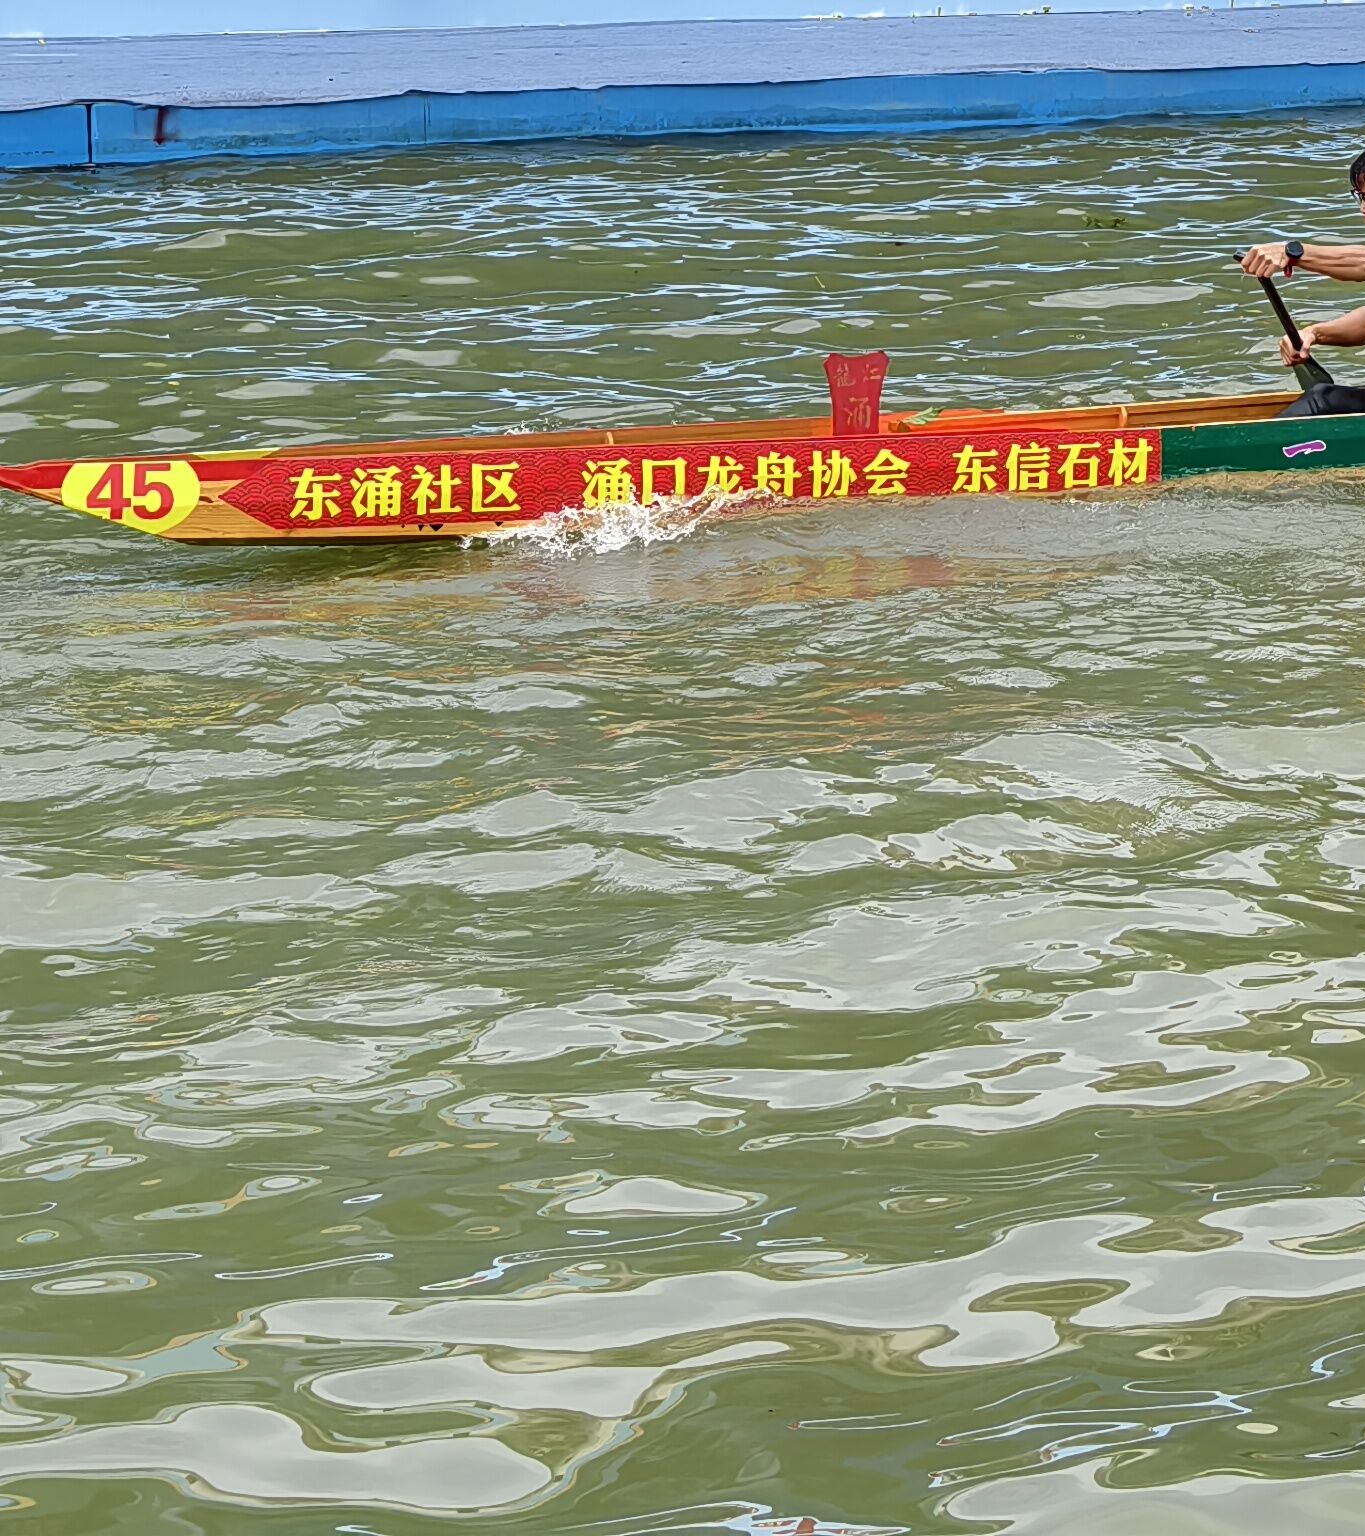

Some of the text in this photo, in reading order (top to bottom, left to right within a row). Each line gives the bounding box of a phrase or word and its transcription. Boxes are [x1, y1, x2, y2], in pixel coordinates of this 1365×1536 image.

[85, 462, 175, 521] 45
[289, 438, 1154, 522] 东涌社区 涌口龙舟协会 东信石材
